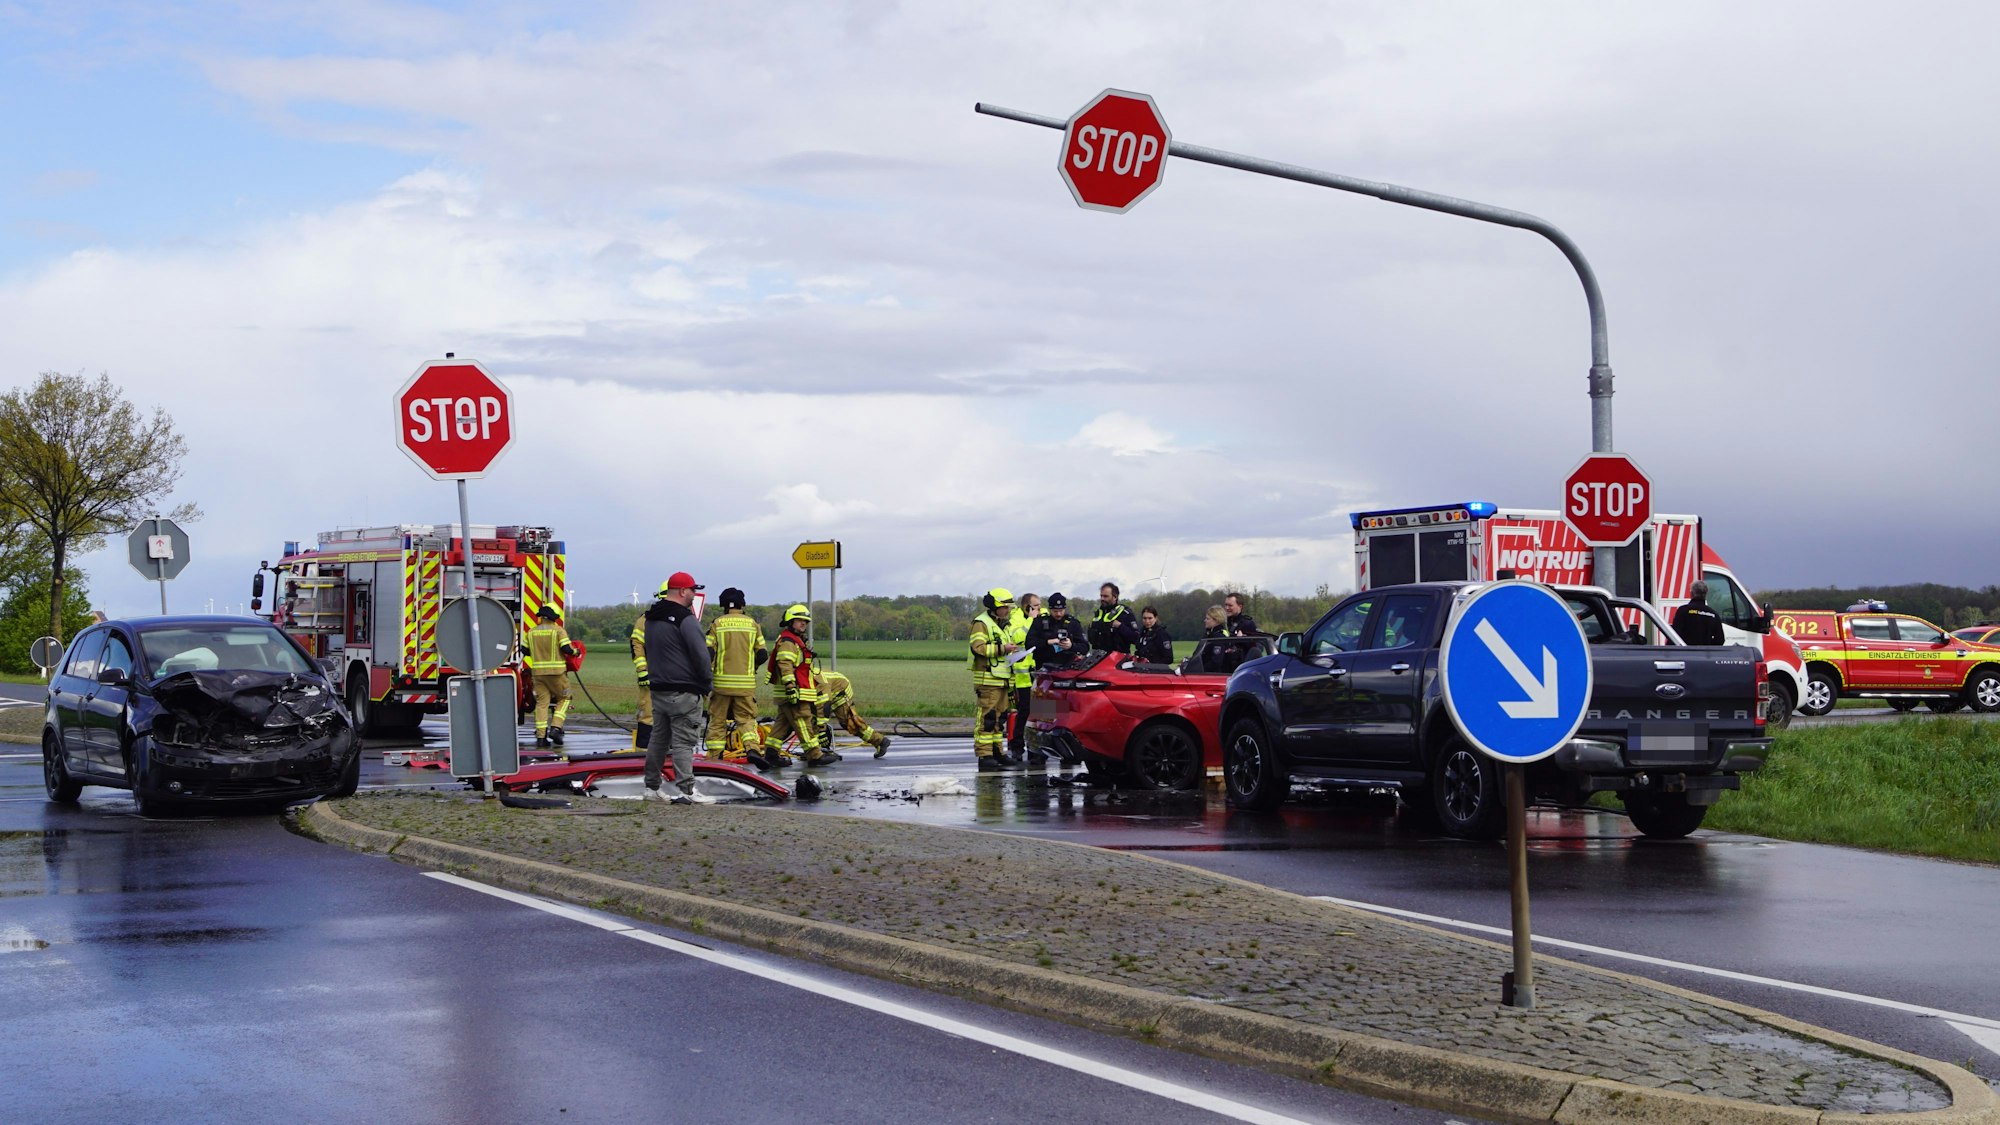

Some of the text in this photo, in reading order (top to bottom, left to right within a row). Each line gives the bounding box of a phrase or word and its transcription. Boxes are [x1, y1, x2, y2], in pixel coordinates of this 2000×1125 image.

[1073, 124, 1159, 178] STOP
[408, 396, 502, 443] STOP
[1571, 481, 1645, 517] STOP
[805, 551, 830, 561] Gladbach
[1499, 549, 1593, 570] NOTRUF
[1790, 621, 1818, 635] 112
[1868, 651, 1942, 659] EINSATZLEITDIENST
[1586, 709, 1748, 720] RANGER
